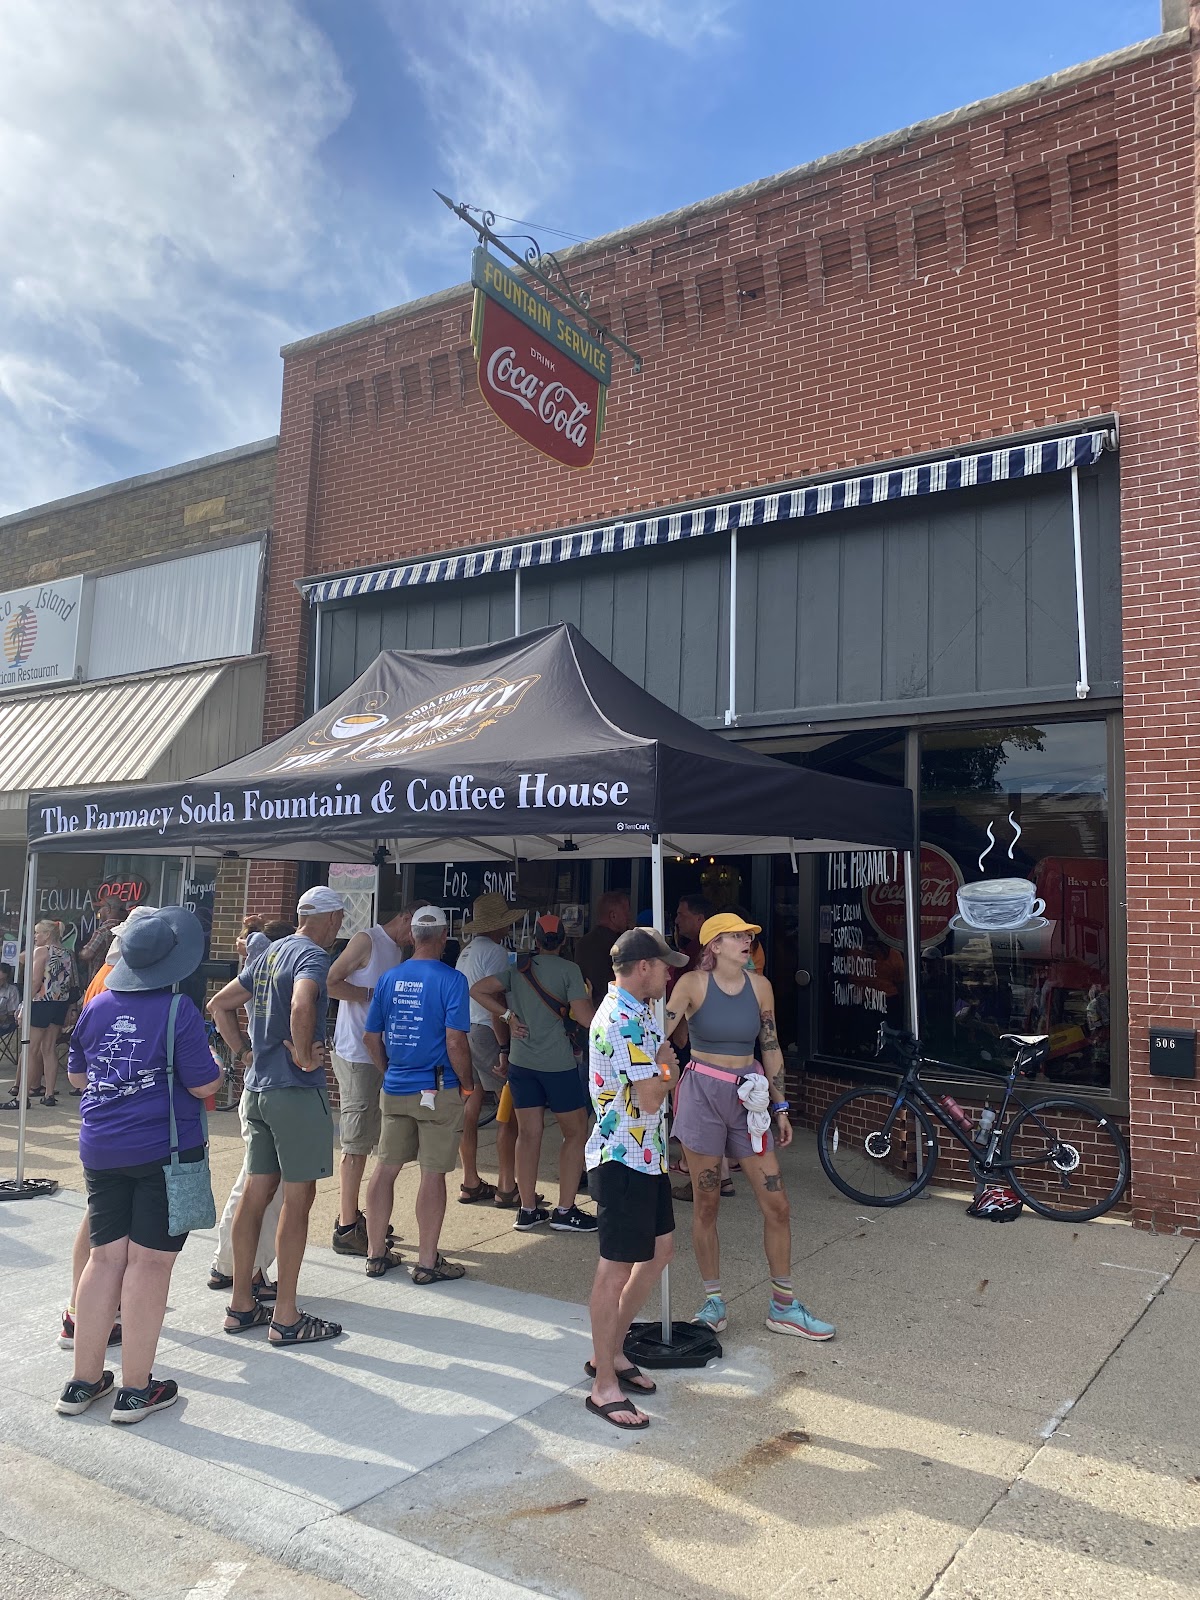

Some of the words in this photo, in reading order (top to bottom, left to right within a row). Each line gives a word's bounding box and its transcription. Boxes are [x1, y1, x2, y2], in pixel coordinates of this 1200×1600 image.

[484, 262, 551, 331] FOUNTAIN
[556, 319, 606, 374] SERVICE
[530, 347, 555, 372] DRINK
[35, 588, 76, 622] Island
[18, 664, 58, 682] Restaurant
[344, 680, 529, 757] FARMACY
[405, 702, 437, 720] SODA
[40, 806, 79, 834] The
[83, 804, 174, 835] Farmacy
[179, 791, 235, 825] Soda
[243, 784, 362, 821] Fountain
[371, 780, 397, 814] &
[406, 775, 505, 812] Coffee
[516, 773, 628, 809] House
[98, 881, 142, 902] OPEN
[483, 870, 517, 902] SOME
[1067, 876, 1088, 886] Have
[1155, 1038, 1175, 1049] 506
